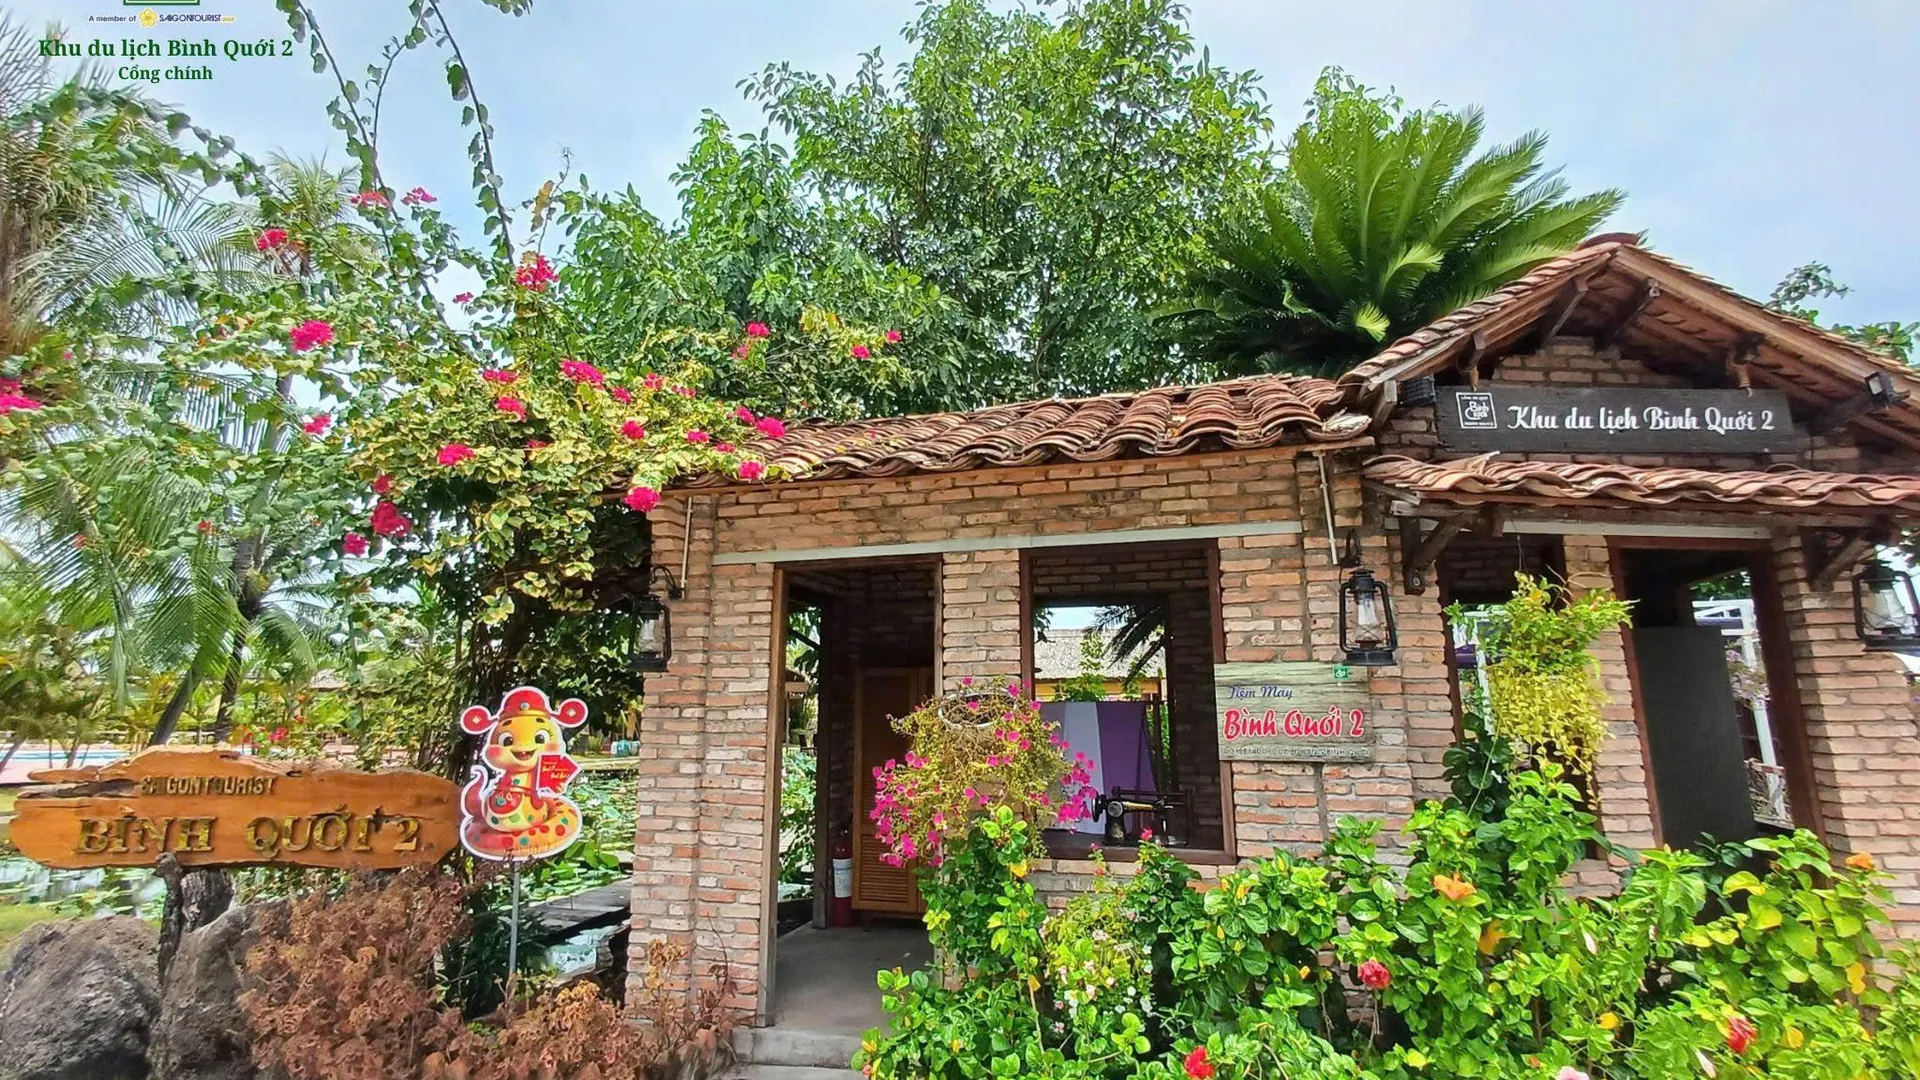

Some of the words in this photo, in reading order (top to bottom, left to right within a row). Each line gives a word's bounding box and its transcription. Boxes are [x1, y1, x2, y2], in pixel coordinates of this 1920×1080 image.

[1507, 405, 1558, 430] Khu
[1565, 406, 1593, 430] du
[1599, 406, 1640, 435] lịch
[1643, 405, 1699, 430] Bình
[1704, 406, 1756, 435] Quới
[1761, 410, 1775, 430] 2
[1229, 685, 1256, 700] Tiệm
[1261, 684, 1293, 700] May
[1223, 707, 1277, 740] Bình
[1283, 704, 1342, 737] Quới
[1350, 708, 1364, 737] 2
[140, 775, 277, 796] SAIGONTOURIST
[392, 816, 421, 853] 2
